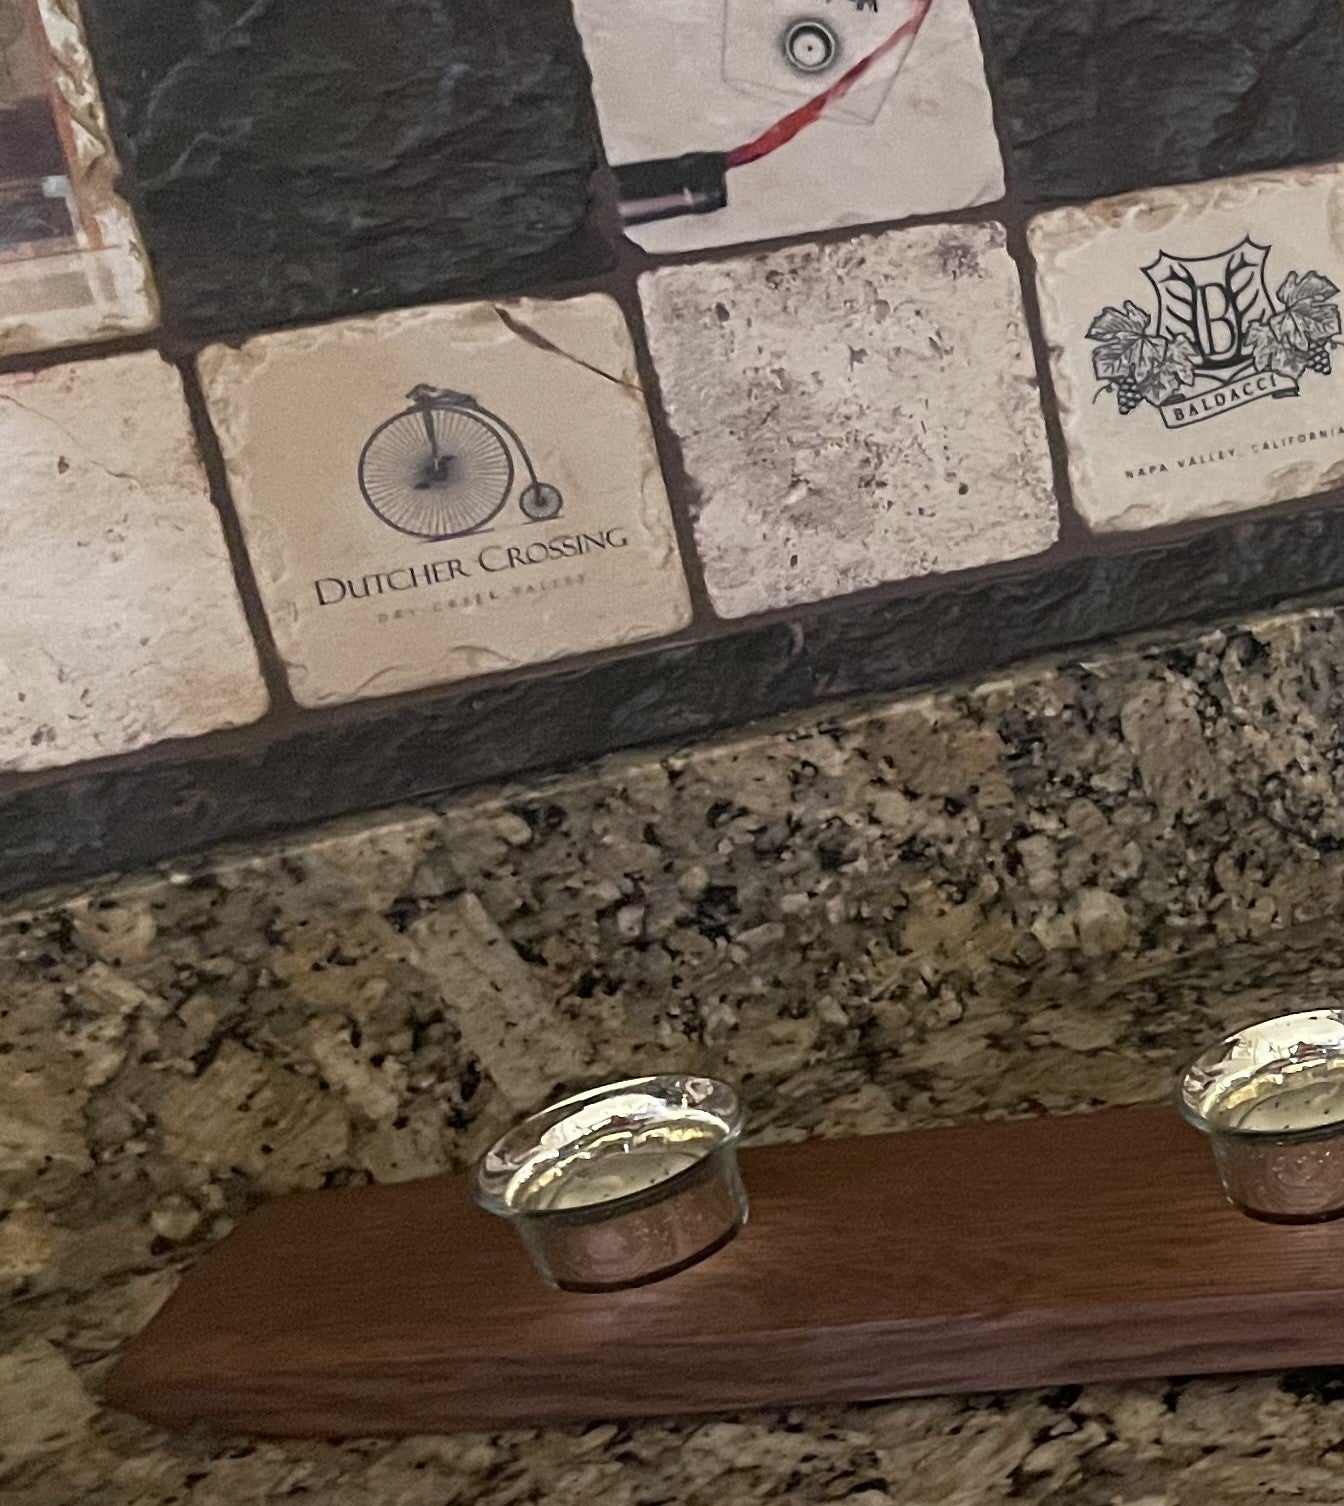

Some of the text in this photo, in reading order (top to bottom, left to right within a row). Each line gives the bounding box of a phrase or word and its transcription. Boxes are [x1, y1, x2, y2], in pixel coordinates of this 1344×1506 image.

[1172, 376, 1277, 422] BALDACCI
[1125, 462, 1169, 480] NAPA
[312, 526, 629, 606] DUTCHER CROSSING
